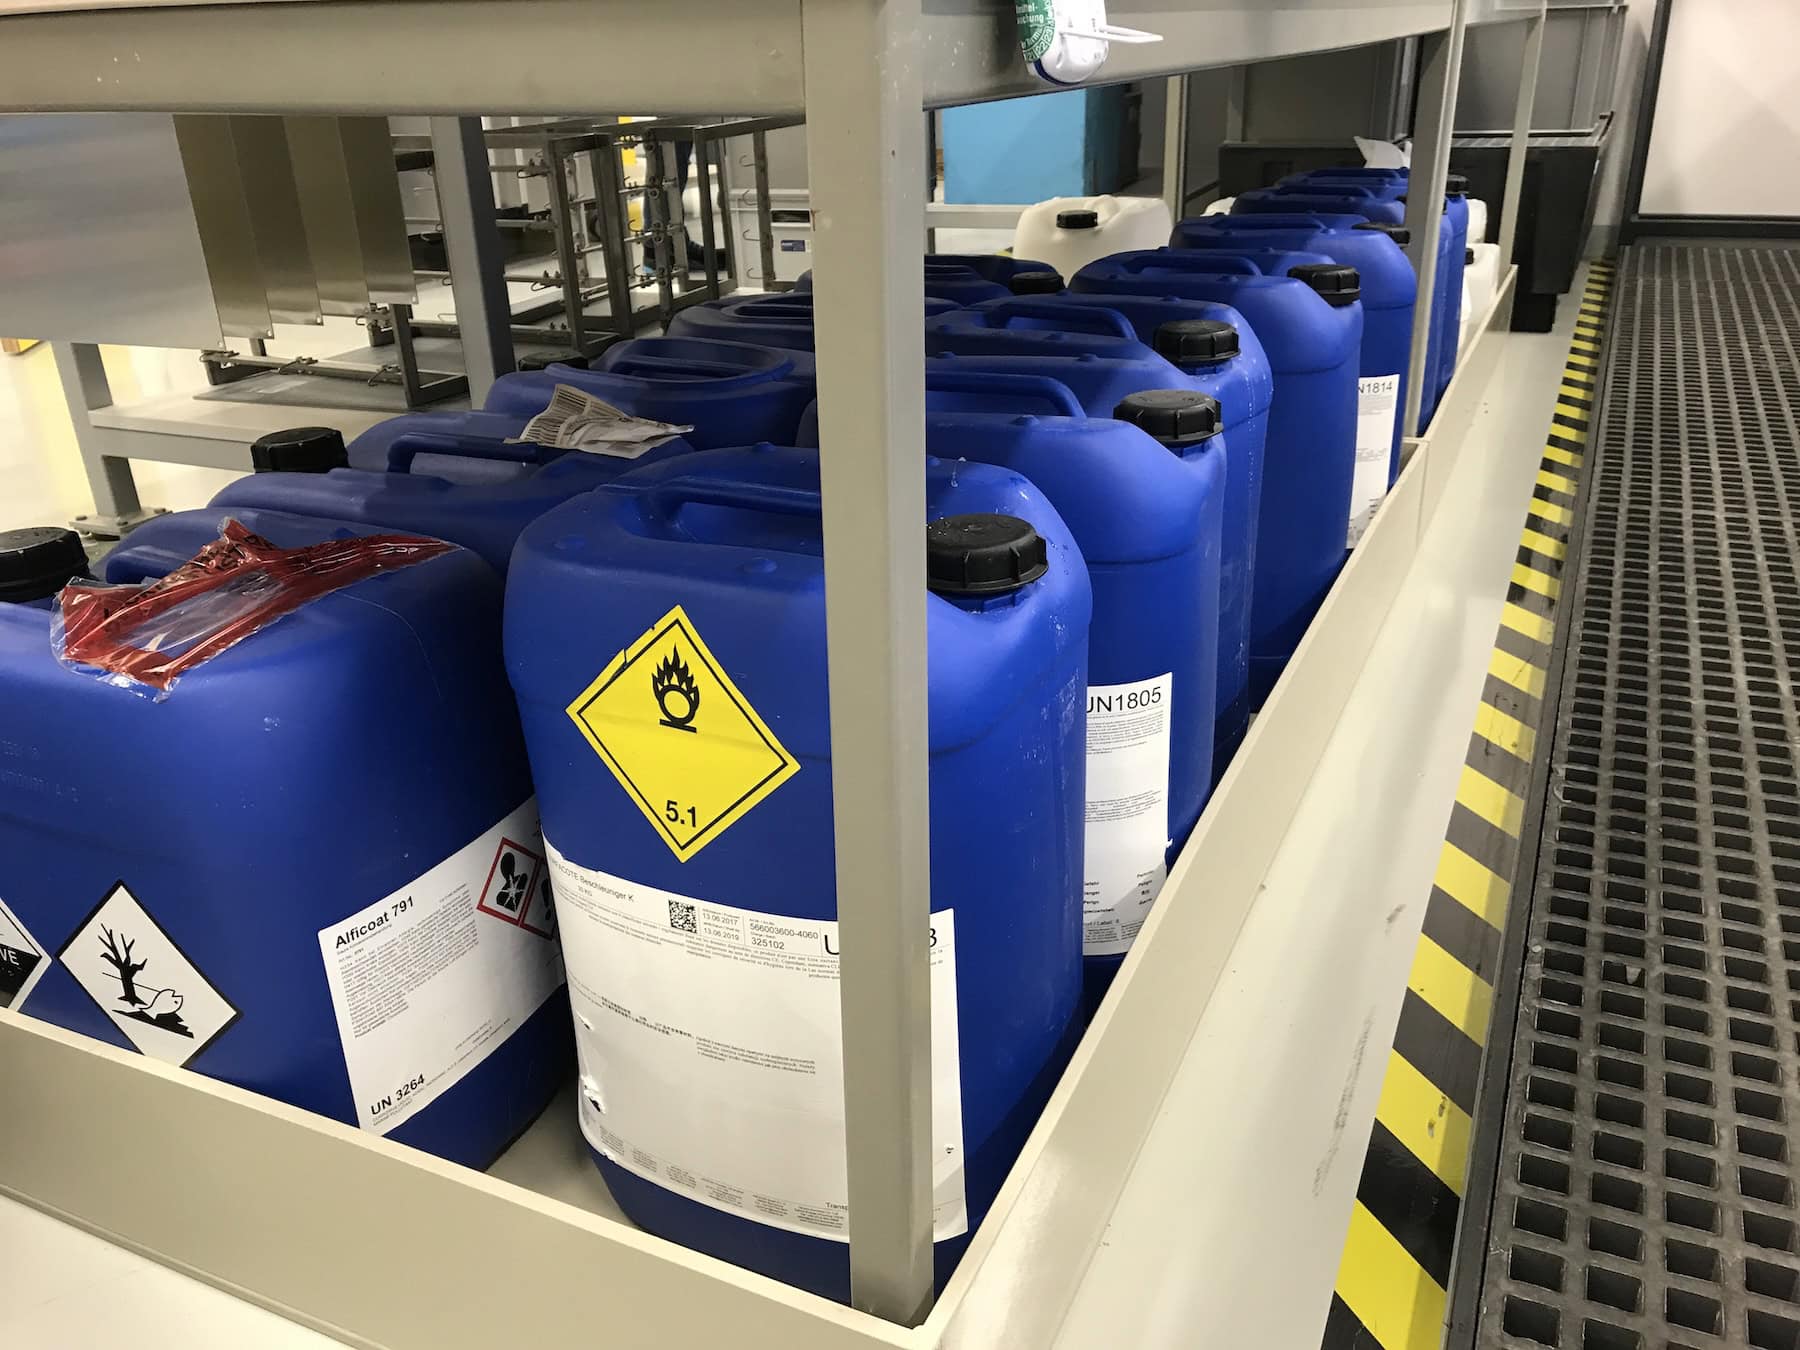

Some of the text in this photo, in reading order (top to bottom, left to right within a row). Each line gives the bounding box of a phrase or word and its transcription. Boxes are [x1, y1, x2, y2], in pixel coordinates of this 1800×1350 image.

[666, 799, 696, 828] 5.1
[335, 895, 414, 949] Alficoat 791
[751, 937, 785, 950] 325102
[371, 1073, 425, 1115] UN 3264
